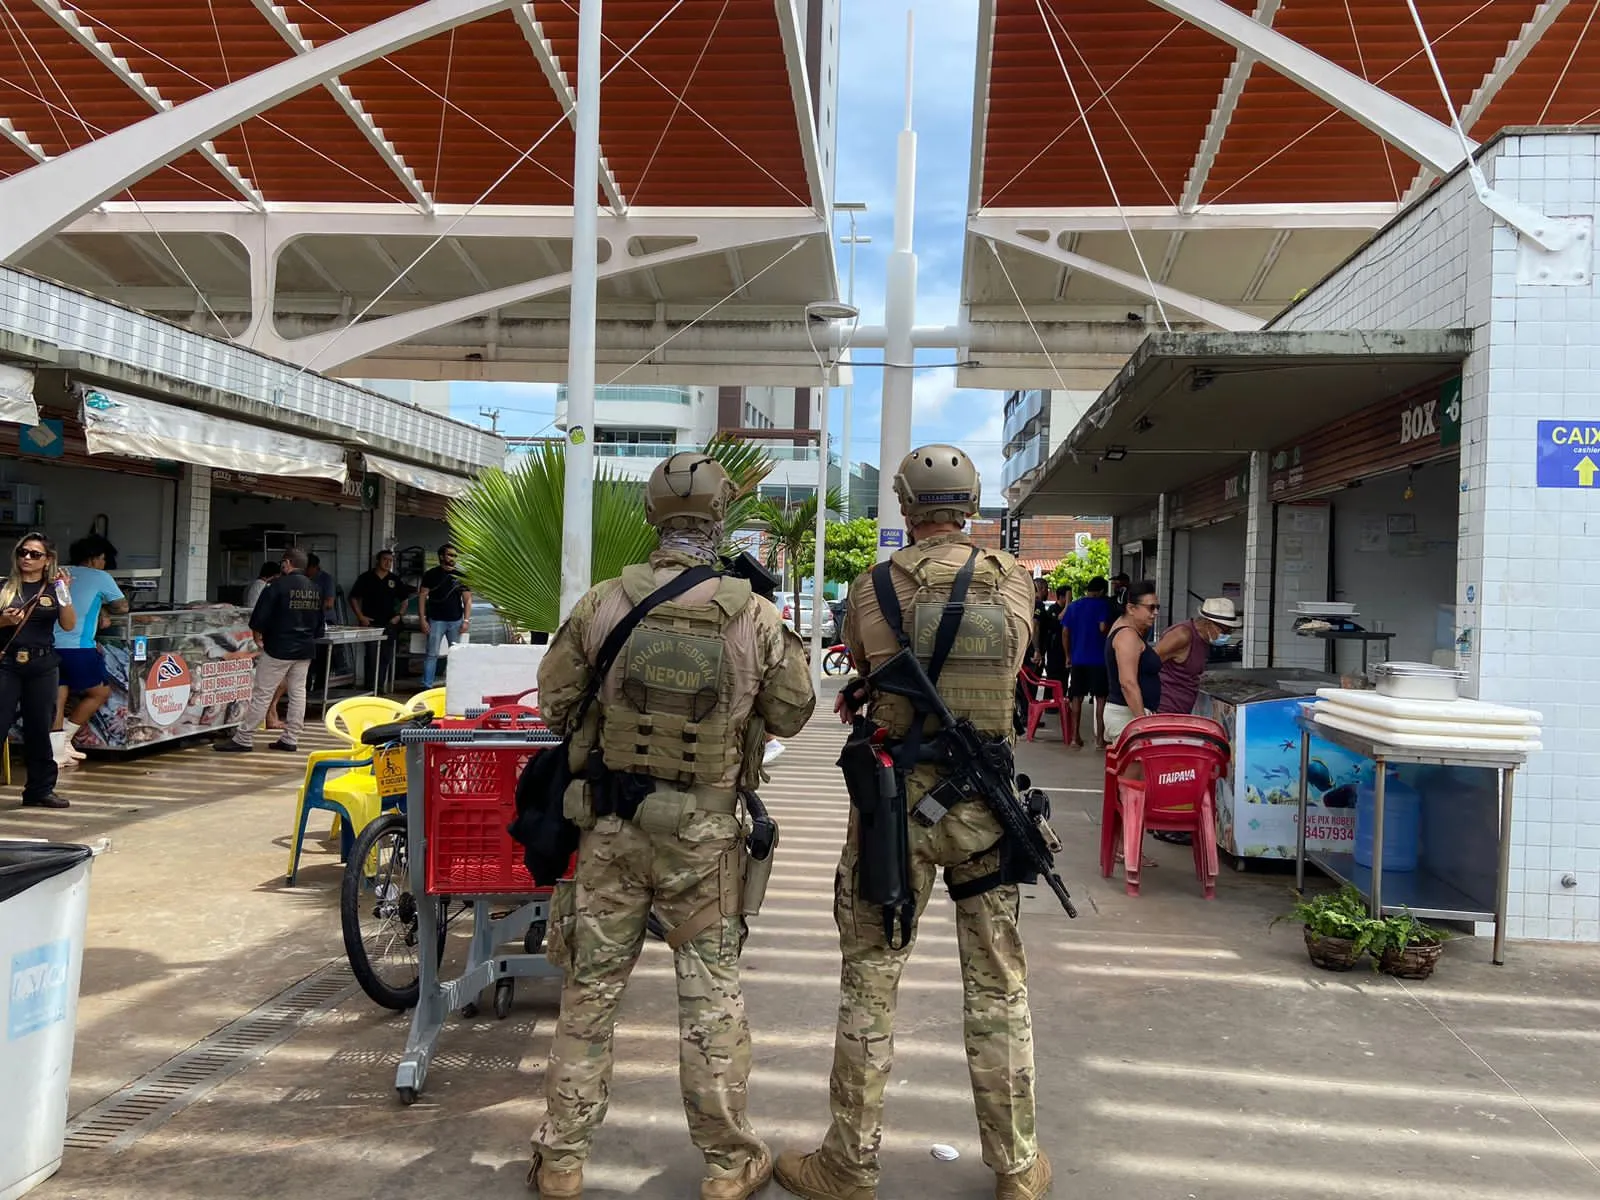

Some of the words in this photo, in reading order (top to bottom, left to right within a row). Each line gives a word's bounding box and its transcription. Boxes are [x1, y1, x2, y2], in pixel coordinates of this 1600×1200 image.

[1401, 400, 1436, 444] BOX
[1449, 390, 1460, 422] 6
[341, 480, 362, 497] BOX
[368, 485, 374, 498] 9
[289, 600, 321, 610] FEDERAL
[676, 641, 715, 683] FEDERAL
[645, 664, 701, 689] NEPOM
[1158, 768, 1196, 785] ITAIPAVA
[1293, 814, 1317, 824] CVE
[1318, 815, 1330, 825] PIX
